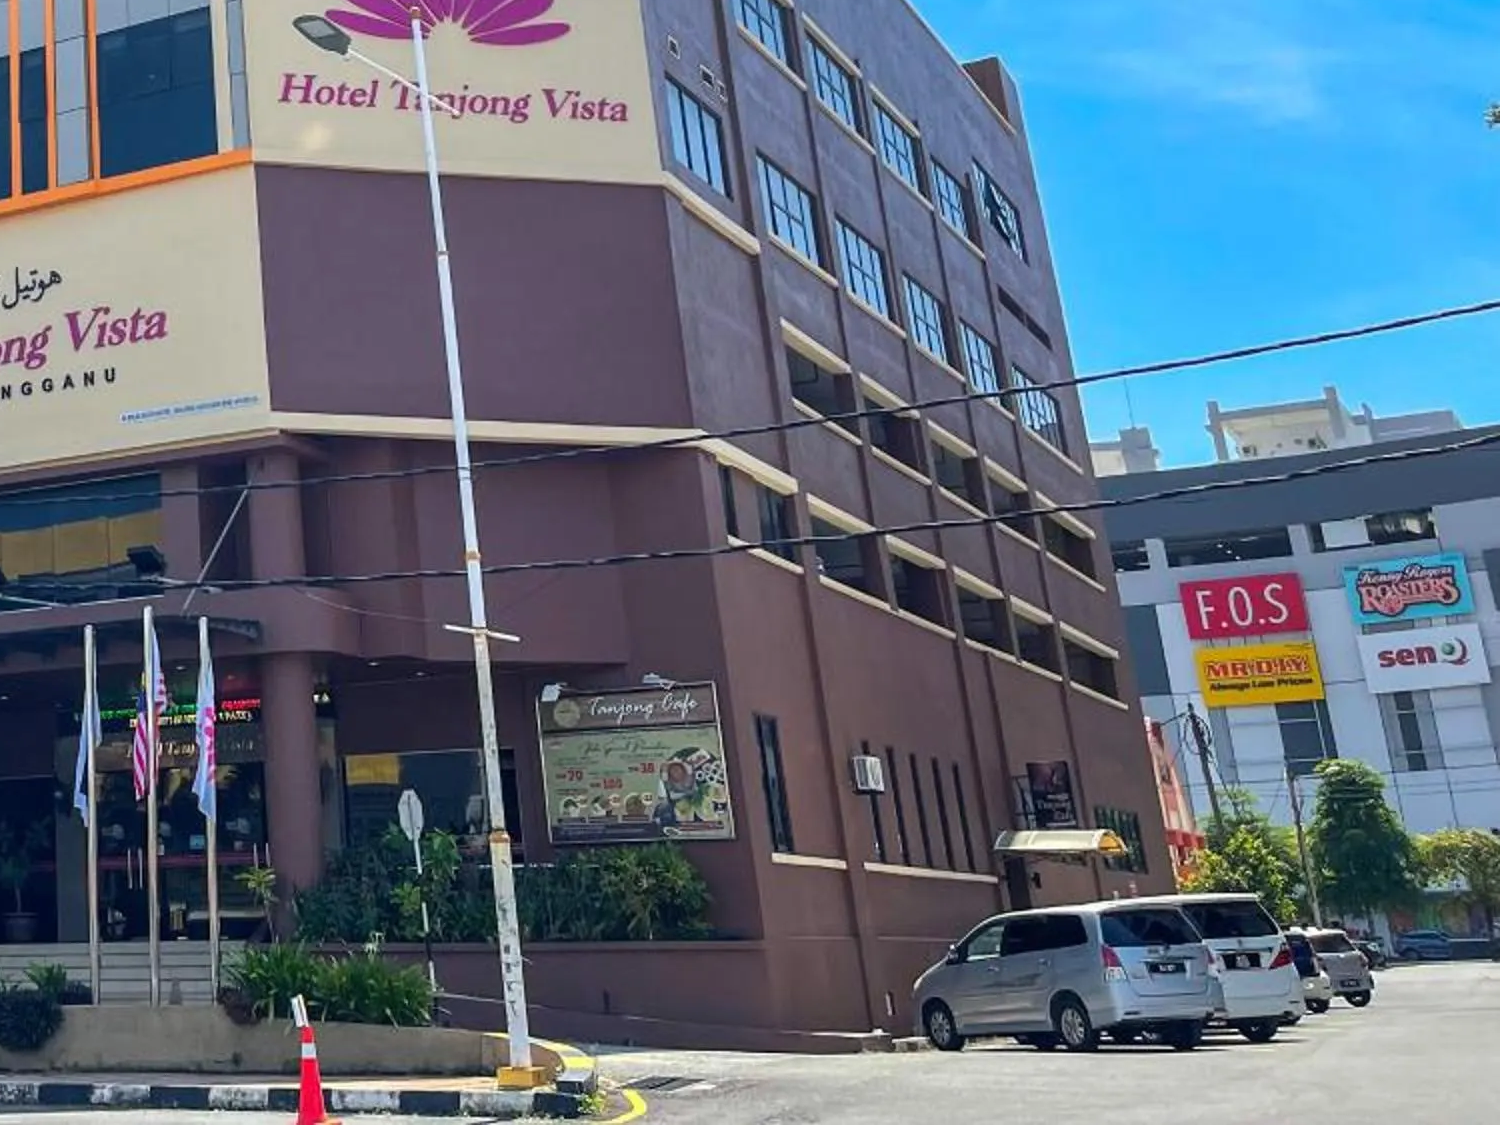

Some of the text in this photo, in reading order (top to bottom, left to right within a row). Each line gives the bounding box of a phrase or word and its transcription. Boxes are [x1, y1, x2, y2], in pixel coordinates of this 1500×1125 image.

[277, 73, 379, 108] Hotel
[541, 87, 629, 122] Vista
[64, 307, 168, 353] Vista
[1195, 582, 1289, 630] F.O.S
[1358, 577, 1458, 612] ROASTERS
